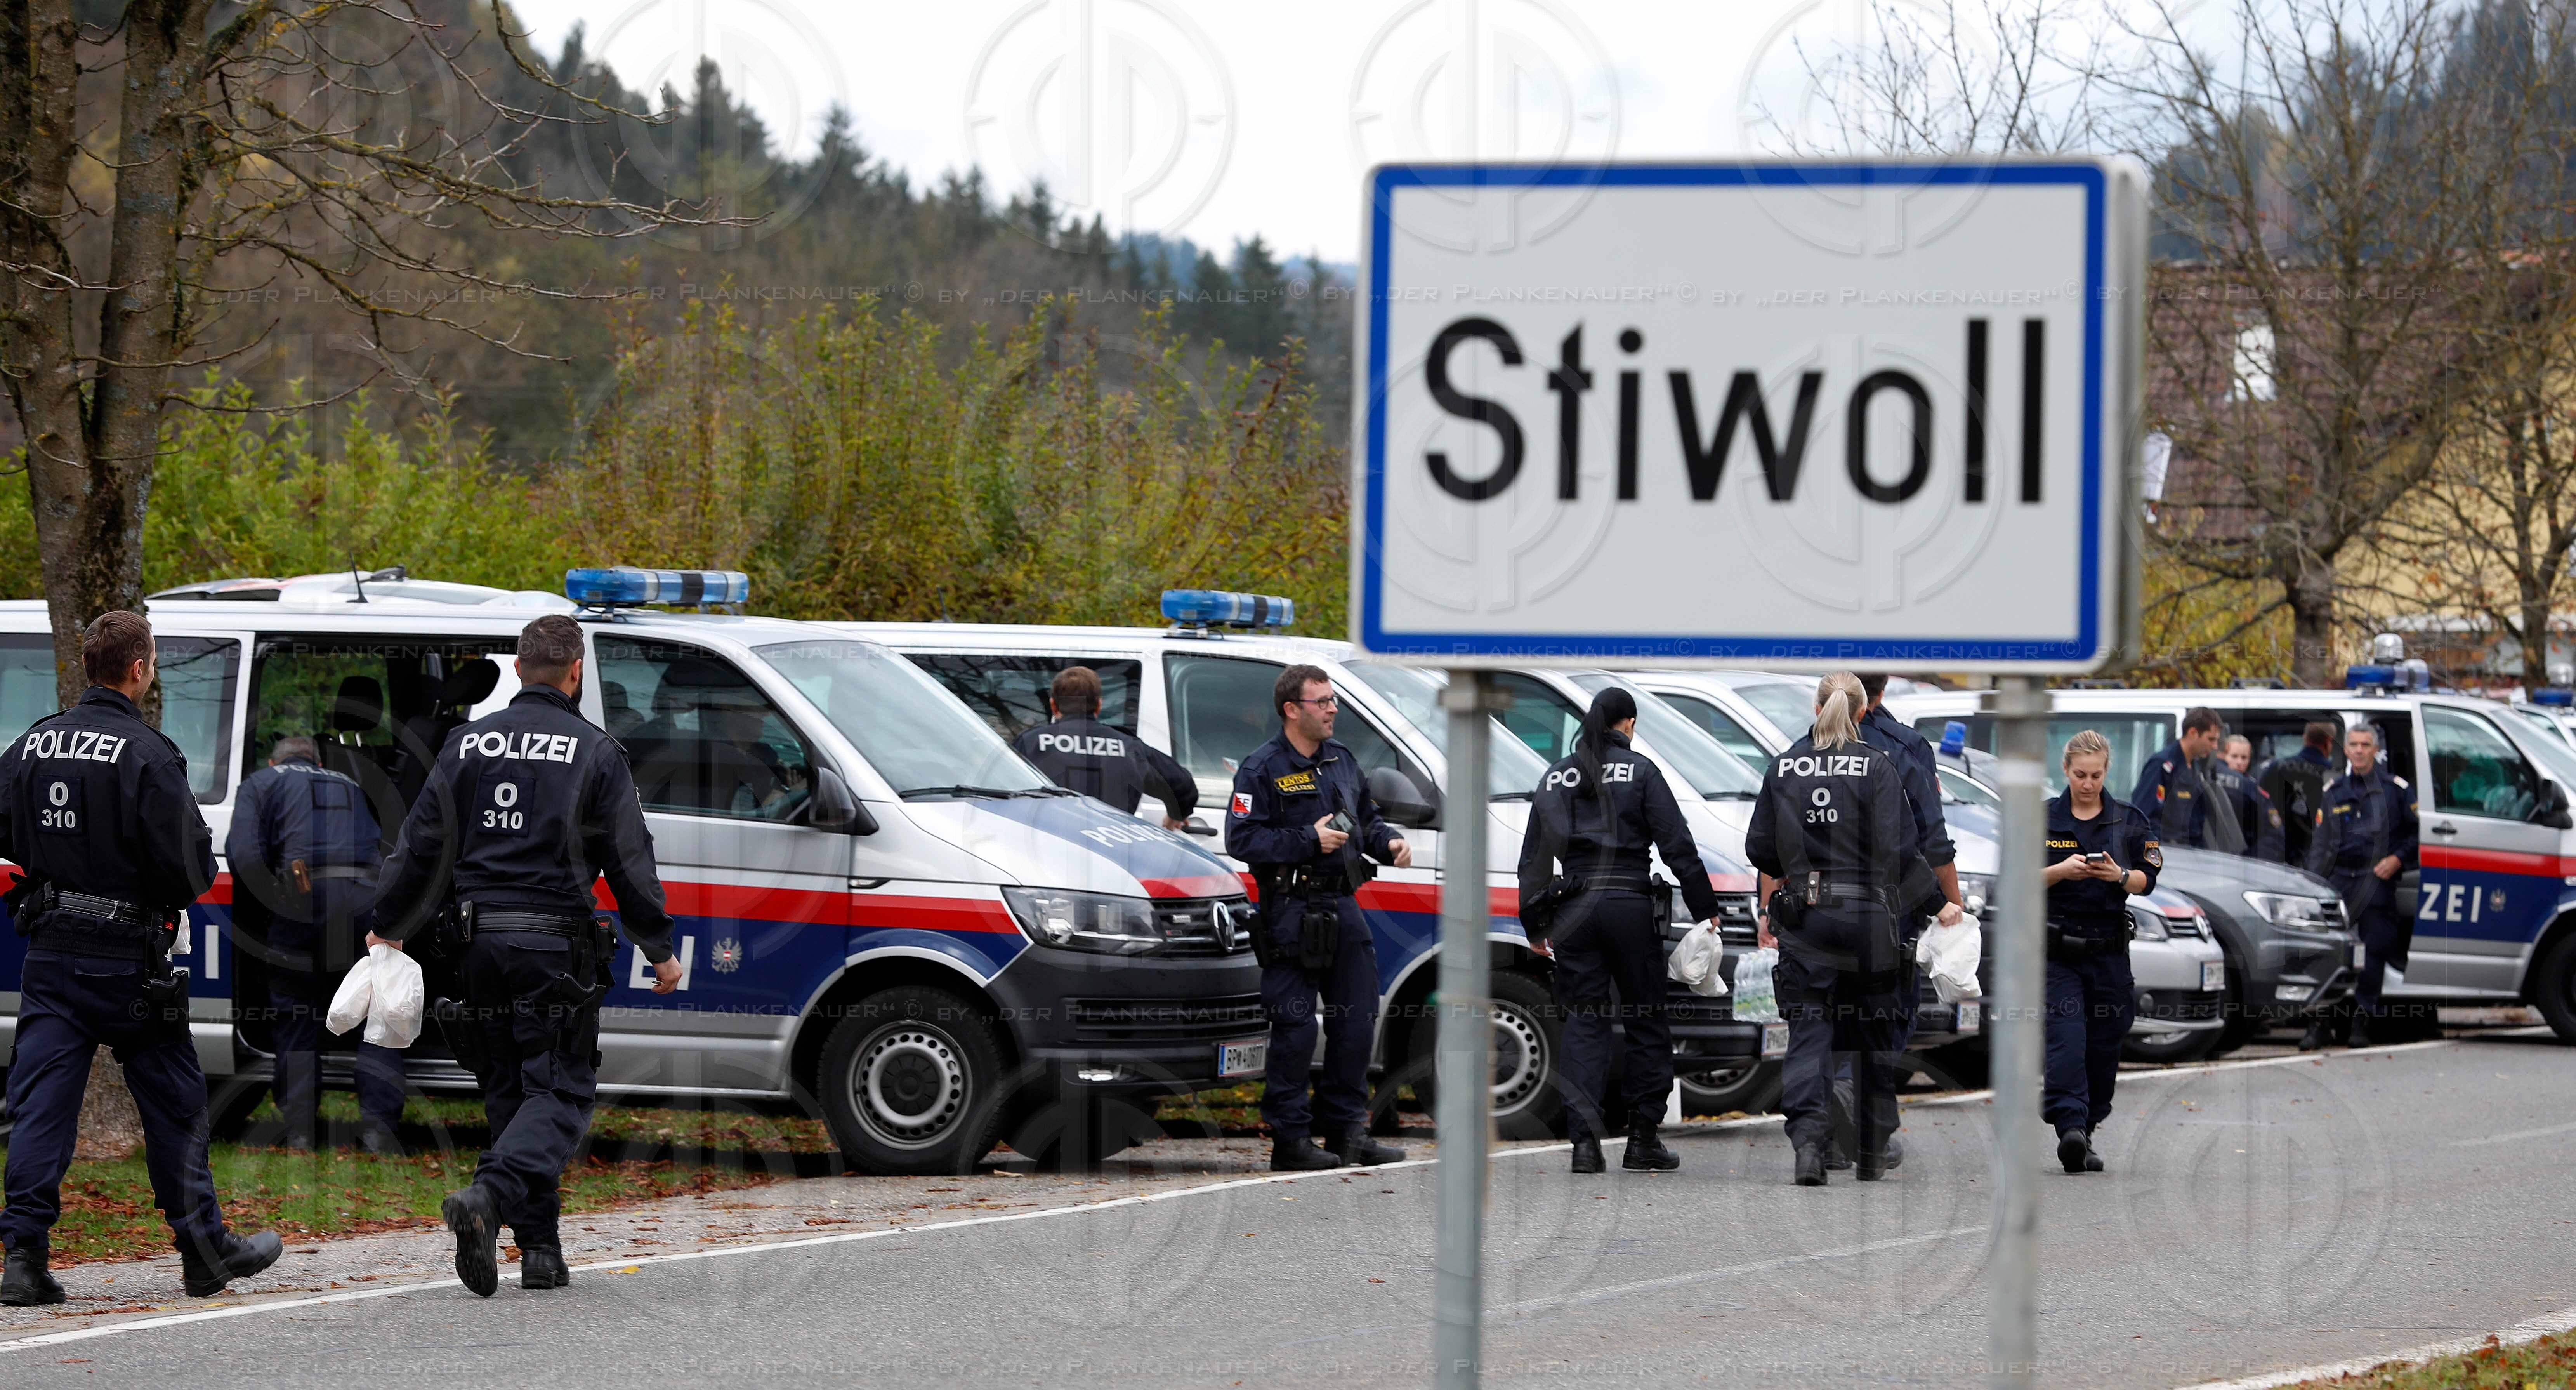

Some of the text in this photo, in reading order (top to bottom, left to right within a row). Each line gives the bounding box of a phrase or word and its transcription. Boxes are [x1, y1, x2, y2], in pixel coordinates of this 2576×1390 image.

[1424, 315, 2045, 504] Stiwoll
[22, 730, 127, 763] POLIZEI
[459, 731, 578, 764] POLIZEI
[1039, 733, 1125, 758] POLIZEI
[1546, 763, 1635, 791] POZEI
[1778, 754, 1870, 778] POLIZEI
[42, 810, 76, 829] 310
[483, 809, 524, 830] 310
[1805, 808, 1838, 824] 310
[2045, 840, 2078, 848] POLIZEI
